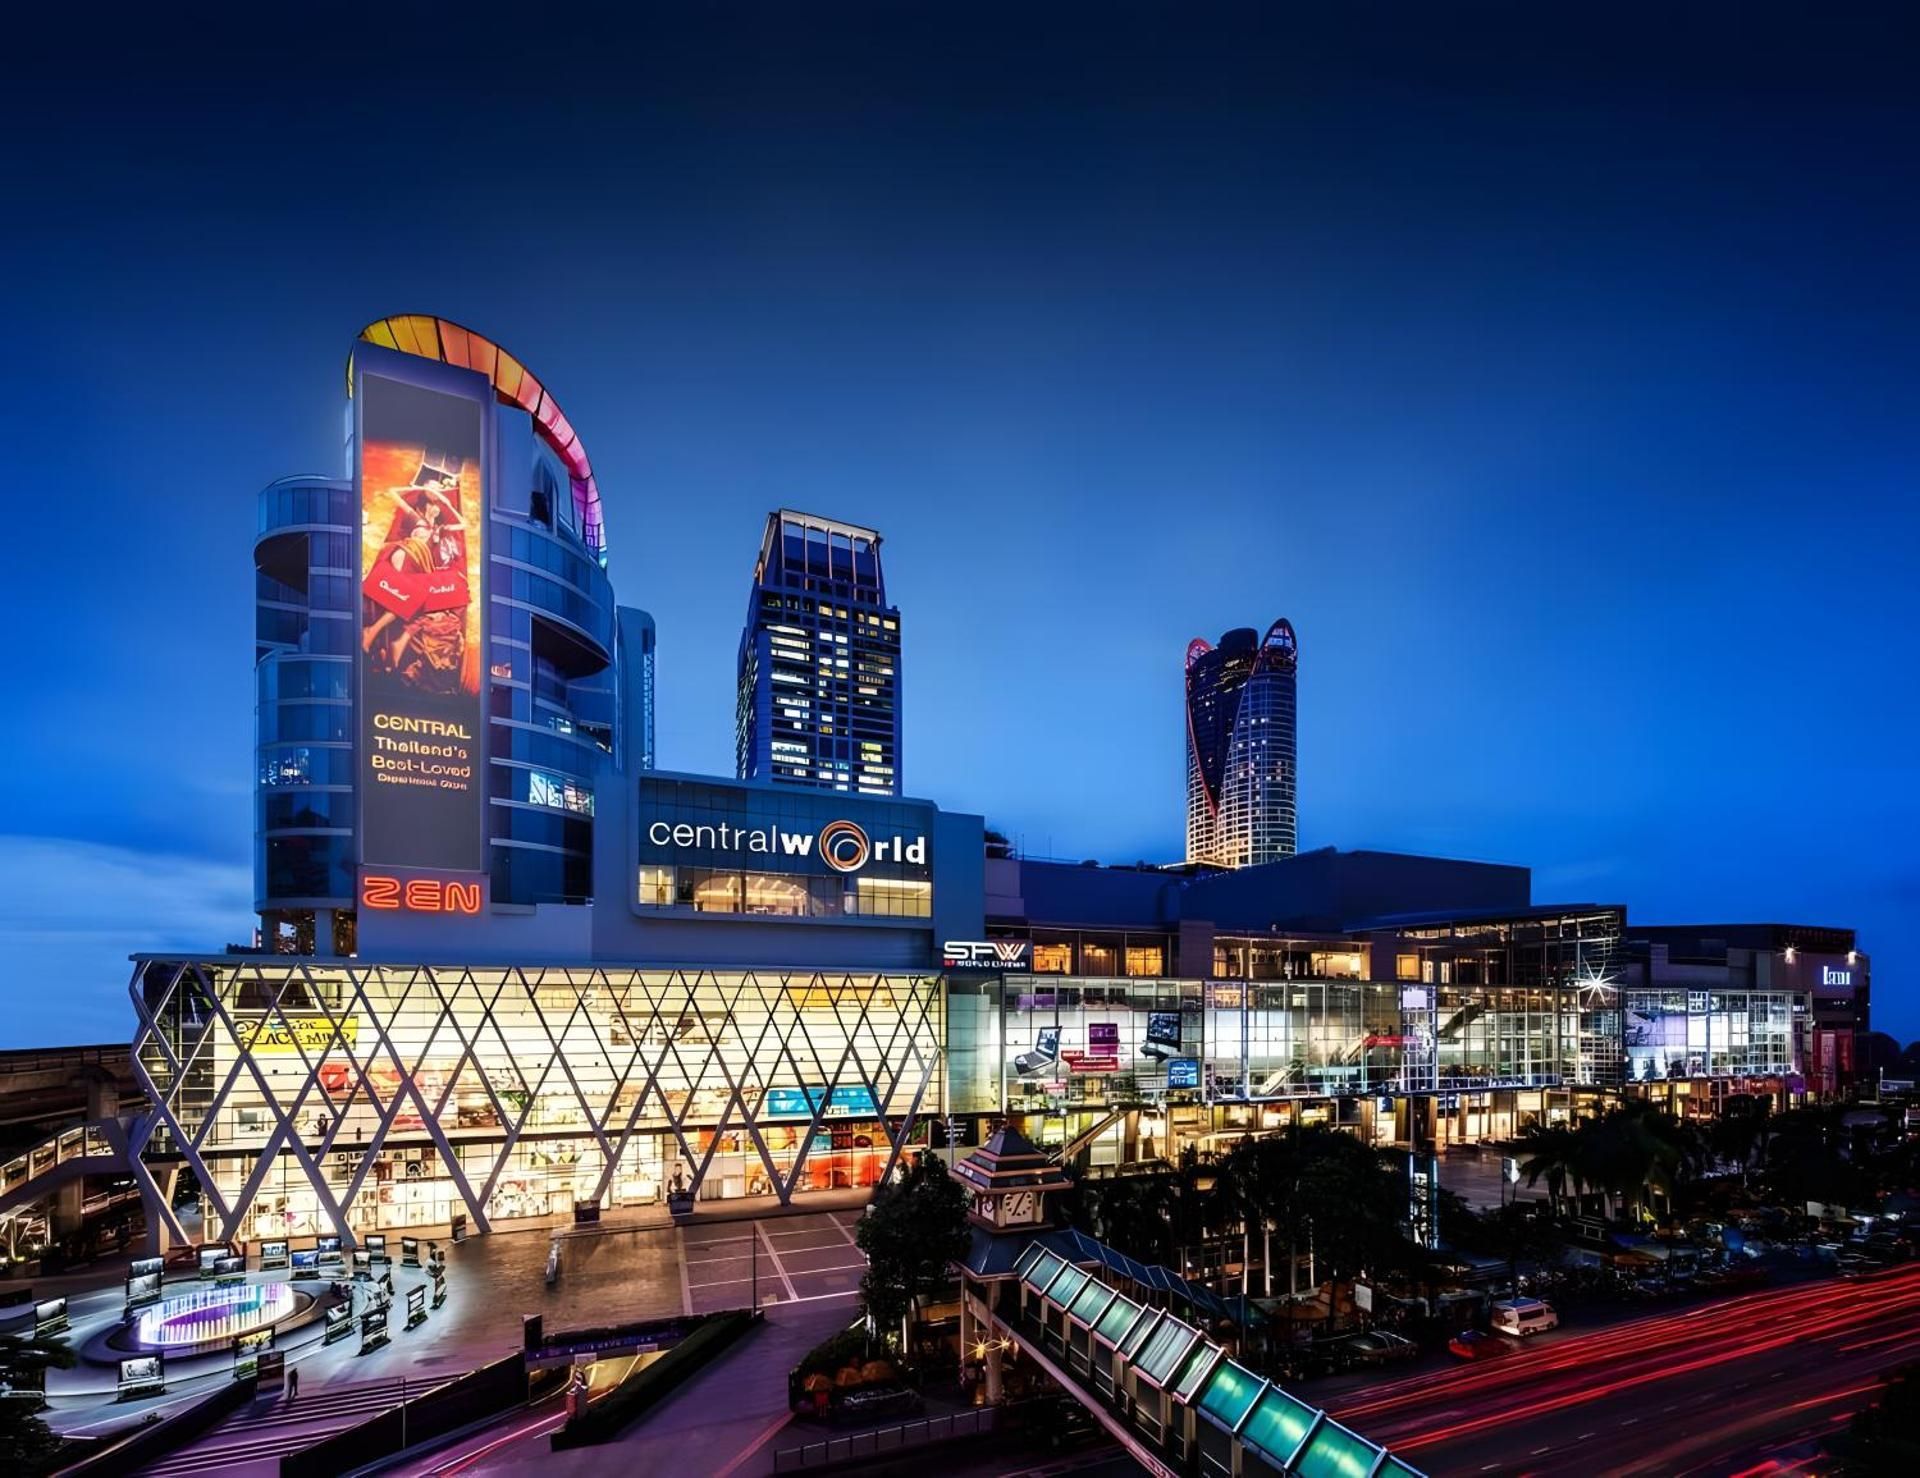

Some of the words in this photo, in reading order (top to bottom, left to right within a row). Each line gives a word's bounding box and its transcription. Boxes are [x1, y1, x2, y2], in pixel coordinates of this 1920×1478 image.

[374, 714, 471, 739] CENTRAL
[649, 819, 925, 872] centralworld
[363, 877, 480, 913] ZEN
[943, 941, 1026, 961] SFW
